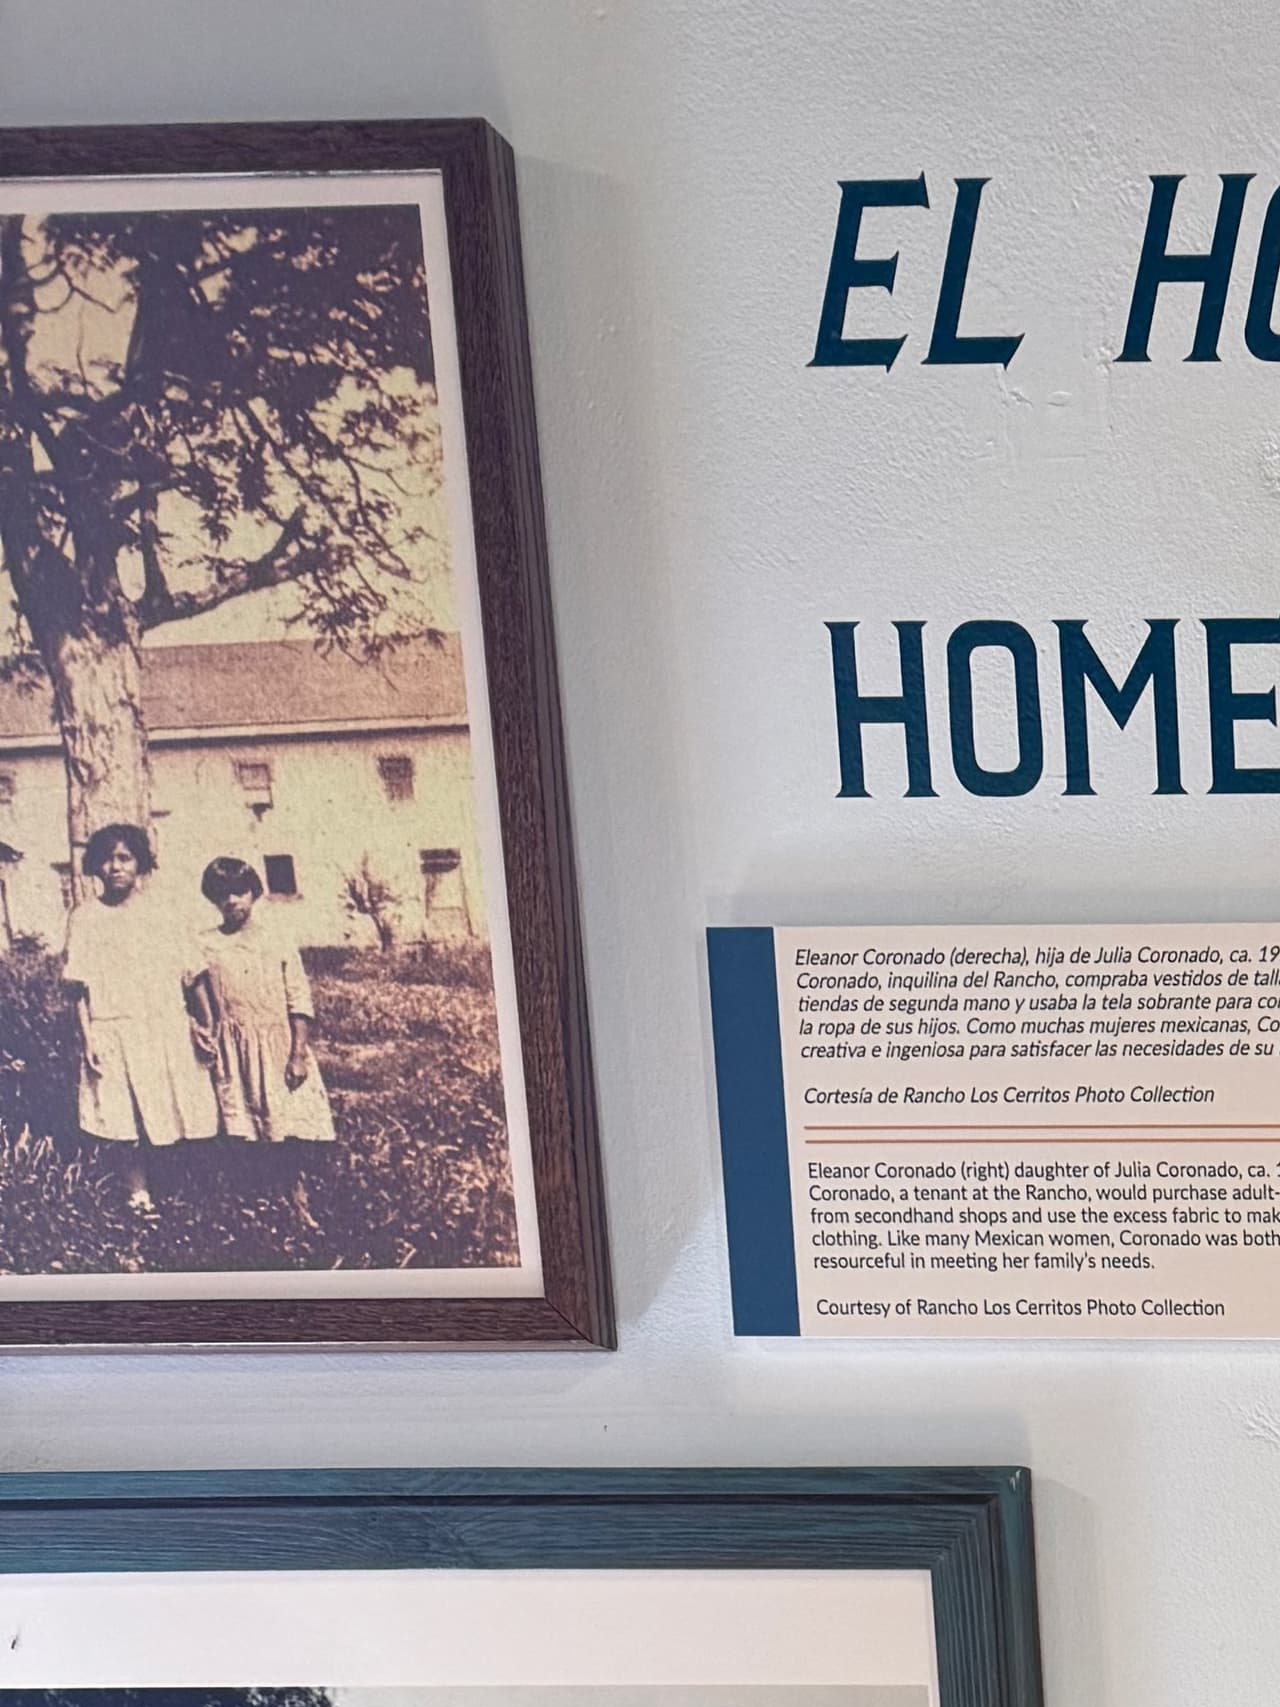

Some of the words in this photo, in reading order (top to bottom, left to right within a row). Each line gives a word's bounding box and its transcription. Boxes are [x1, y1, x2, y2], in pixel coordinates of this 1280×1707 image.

[805, 171, 1024, 374] EL
[794, 948, 860, 966] Eleanor
[862, 946, 946, 966] Coronado
[949, 946, 1030, 968] (derecha),
[1034, 946, 1065, 968] hija
[1069, 945, 1092, 965] de
[1093, 945, 1133, 965] Julia
[1137, 945, 1224, 966] Coronado,
[1229, 949, 1253, 964] ca.
[803, 1087, 873, 1105] Cortesía
[877, 1086, 899, 1104] de
[903, 1086, 966, 1104] Rancho
[970, 1086, 999, 1104] Los
[1003, 1085, 1071, 1104] Cerritos
[1074, 1085, 1126, 1104] Photo
[1129, 1084, 1215, 1103] Collection
[808, 1183, 895, 1204] Coronado,
[899, 1188, 909, 1201] a
[912, 1185, 969, 1202] tenant
[972, 1185, 989, 1201] at
[992, 1183, 1021, 1201] the
[1025, 1183, 1092, 1204] Rancho,
[1095, 1183, 1148, 1201] would
[1152, 1183, 1228, 1204] purchase
[811, 1229, 883, 1250] clothing.
[887, 1229, 921, 1247] Like
[924, 1233, 971, 1251] many
[974, 1229, 1045, 1247] Mexican
[1047, 1233, 1115, 1249] women,
[1119, 1229, 1202, 1247] Coronado
[1204, 1233, 1239, 1247] was
